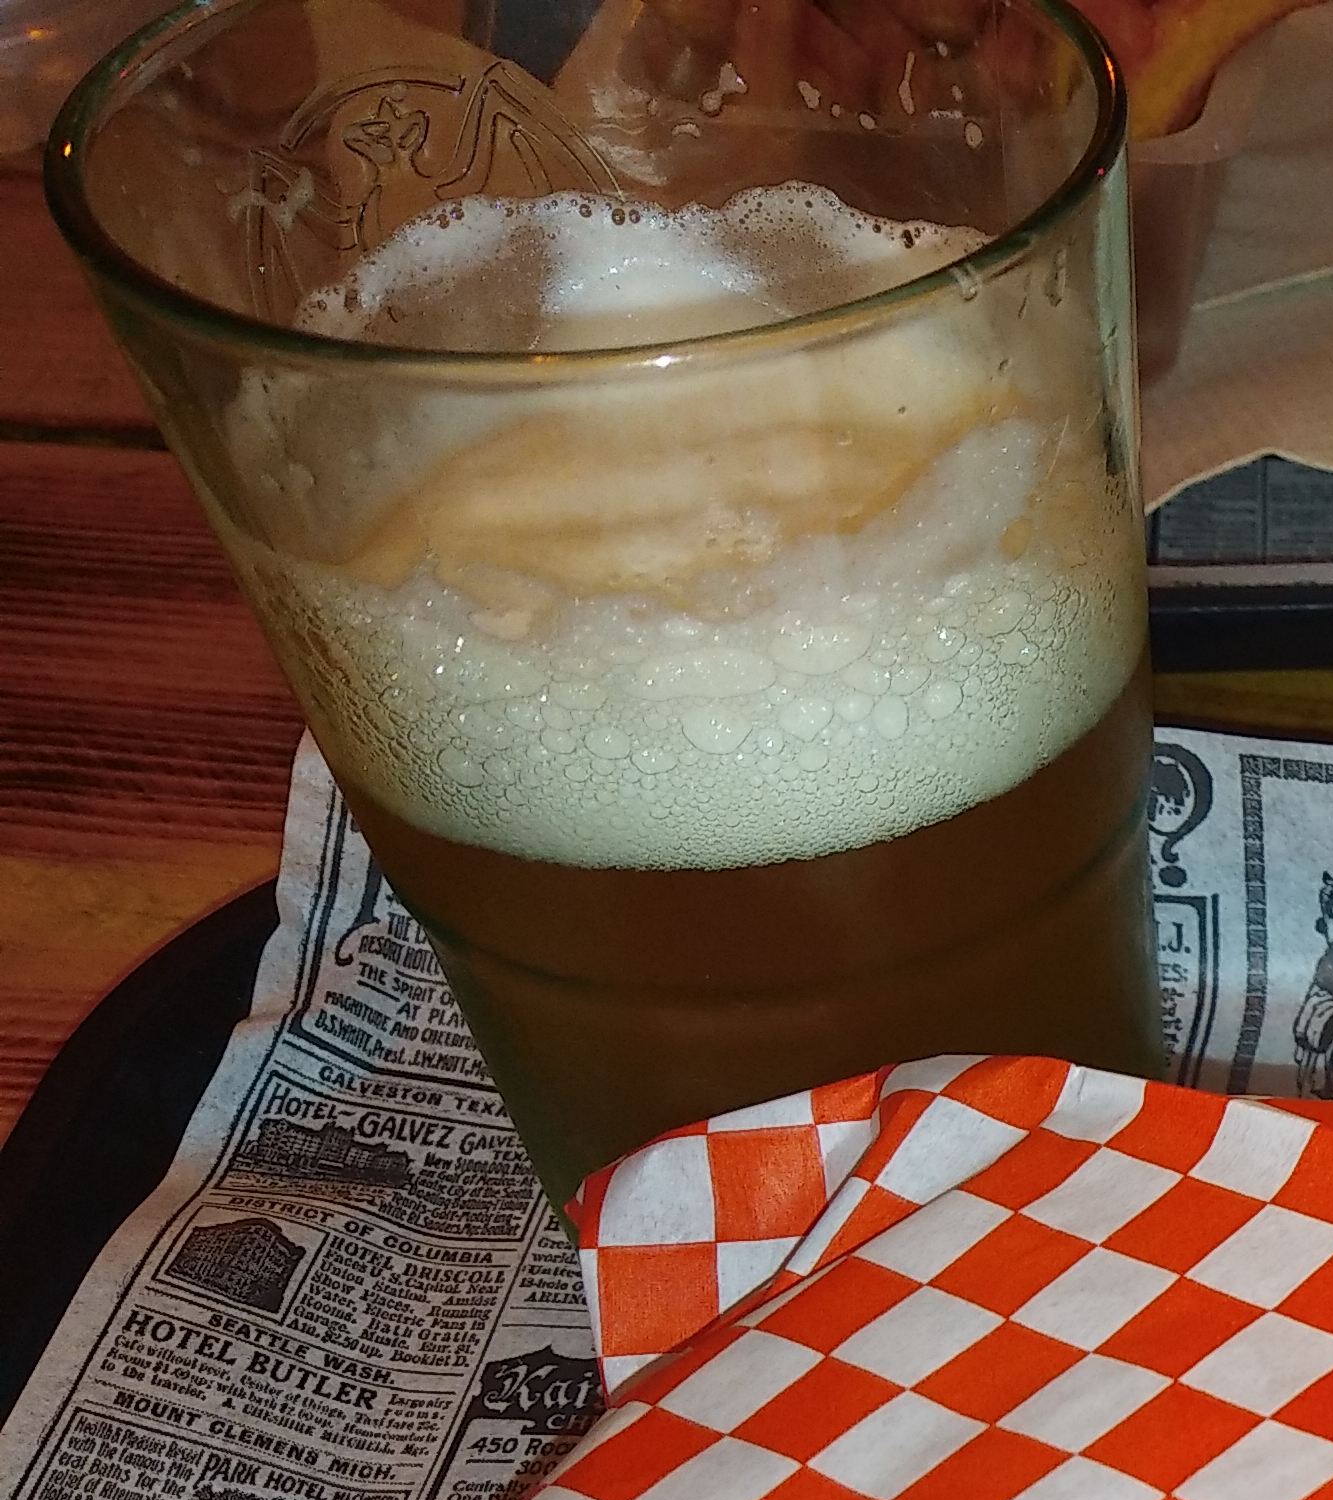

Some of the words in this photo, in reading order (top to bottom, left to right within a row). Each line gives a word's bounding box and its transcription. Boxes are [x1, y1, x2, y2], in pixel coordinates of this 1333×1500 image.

[358, 962, 388, 985] THE
[393, 977, 436, 1003] SPIRIT
[397, 1001, 420, 1021] AT
[390, 1022, 419, 1042] AND
[319, 1065, 443, 1107] GALVESTON
[357, 1112, 454, 1149] GALVEZ
[231, 1197, 334, 1223] DISTRICT
[344, 1221, 374, 1237] OF
[382, 1234, 494, 1264] COLUMBIA
[323, 1249, 366, 1273] Faces
[467, 1284, 503, 1295] Near
[330, 1235, 394, 1271] HOTEL
[403, 1263, 505, 1284] DRISCOLL
[311, 1270, 355, 1293] Show
[360, 1289, 414, 1314] Places.
[427, 1306, 492, 1321] Running
[319, 1259, 364, 1286] Union
[441, 1296, 497, 1306] Amidst
[362, 1303, 425, 1328] Electric
[430, 1318, 466, 1331] Fans
[470, 1320, 486, 1331] in
[367, 1318, 413, 1338] Bath
[122, 1309, 238, 1366] HOTEL
[245, 1351, 378, 1410] BUTLER
[208, 1313, 310, 1359] SEATTLE
[323, 1353, 395, 1385] WASH.
[389, 1349, 449, 1368] Booklet
[452, 1356, 470, 1367] D.
[101, 1358, 116, 1372] to
[122, 1365, 146, 1382] the
[106, 1347, 152, 1369] Rooms
[216, 1381, 247, 1400] with
[147, 1345, 198, 1369] without
[240, 1374, 284, 1397] Center
[285, 1392, 301, 1402] of
[483, 1364, 602, 1412] Kai
[74, 1415, 111, 1441] Health
[112, 1391, 201, 1426] MOUNT
[209, 1420, 319, 1466] CLEMENS
[328, 1458, 396, 1481] MICH.
[467, 1437, 518, 1456] 450
[58, 1451, 89, 1470] eral
[88, 1458, 131, 1483] Baths
[134, 1471, 160, 1491] for
[160, 1478, 186, 1500] the
[67, 1435, 97, 1455] with
[97, 1441, 118, 1460] the
[118, 1448, 166, 1475] famous
[193, 1450, 262, 1490] PARK
[49, 1468, 87, 1490] relief
[85, 1473, 102, 1494] of
[452, 1479, 531, 1494] Centrally
